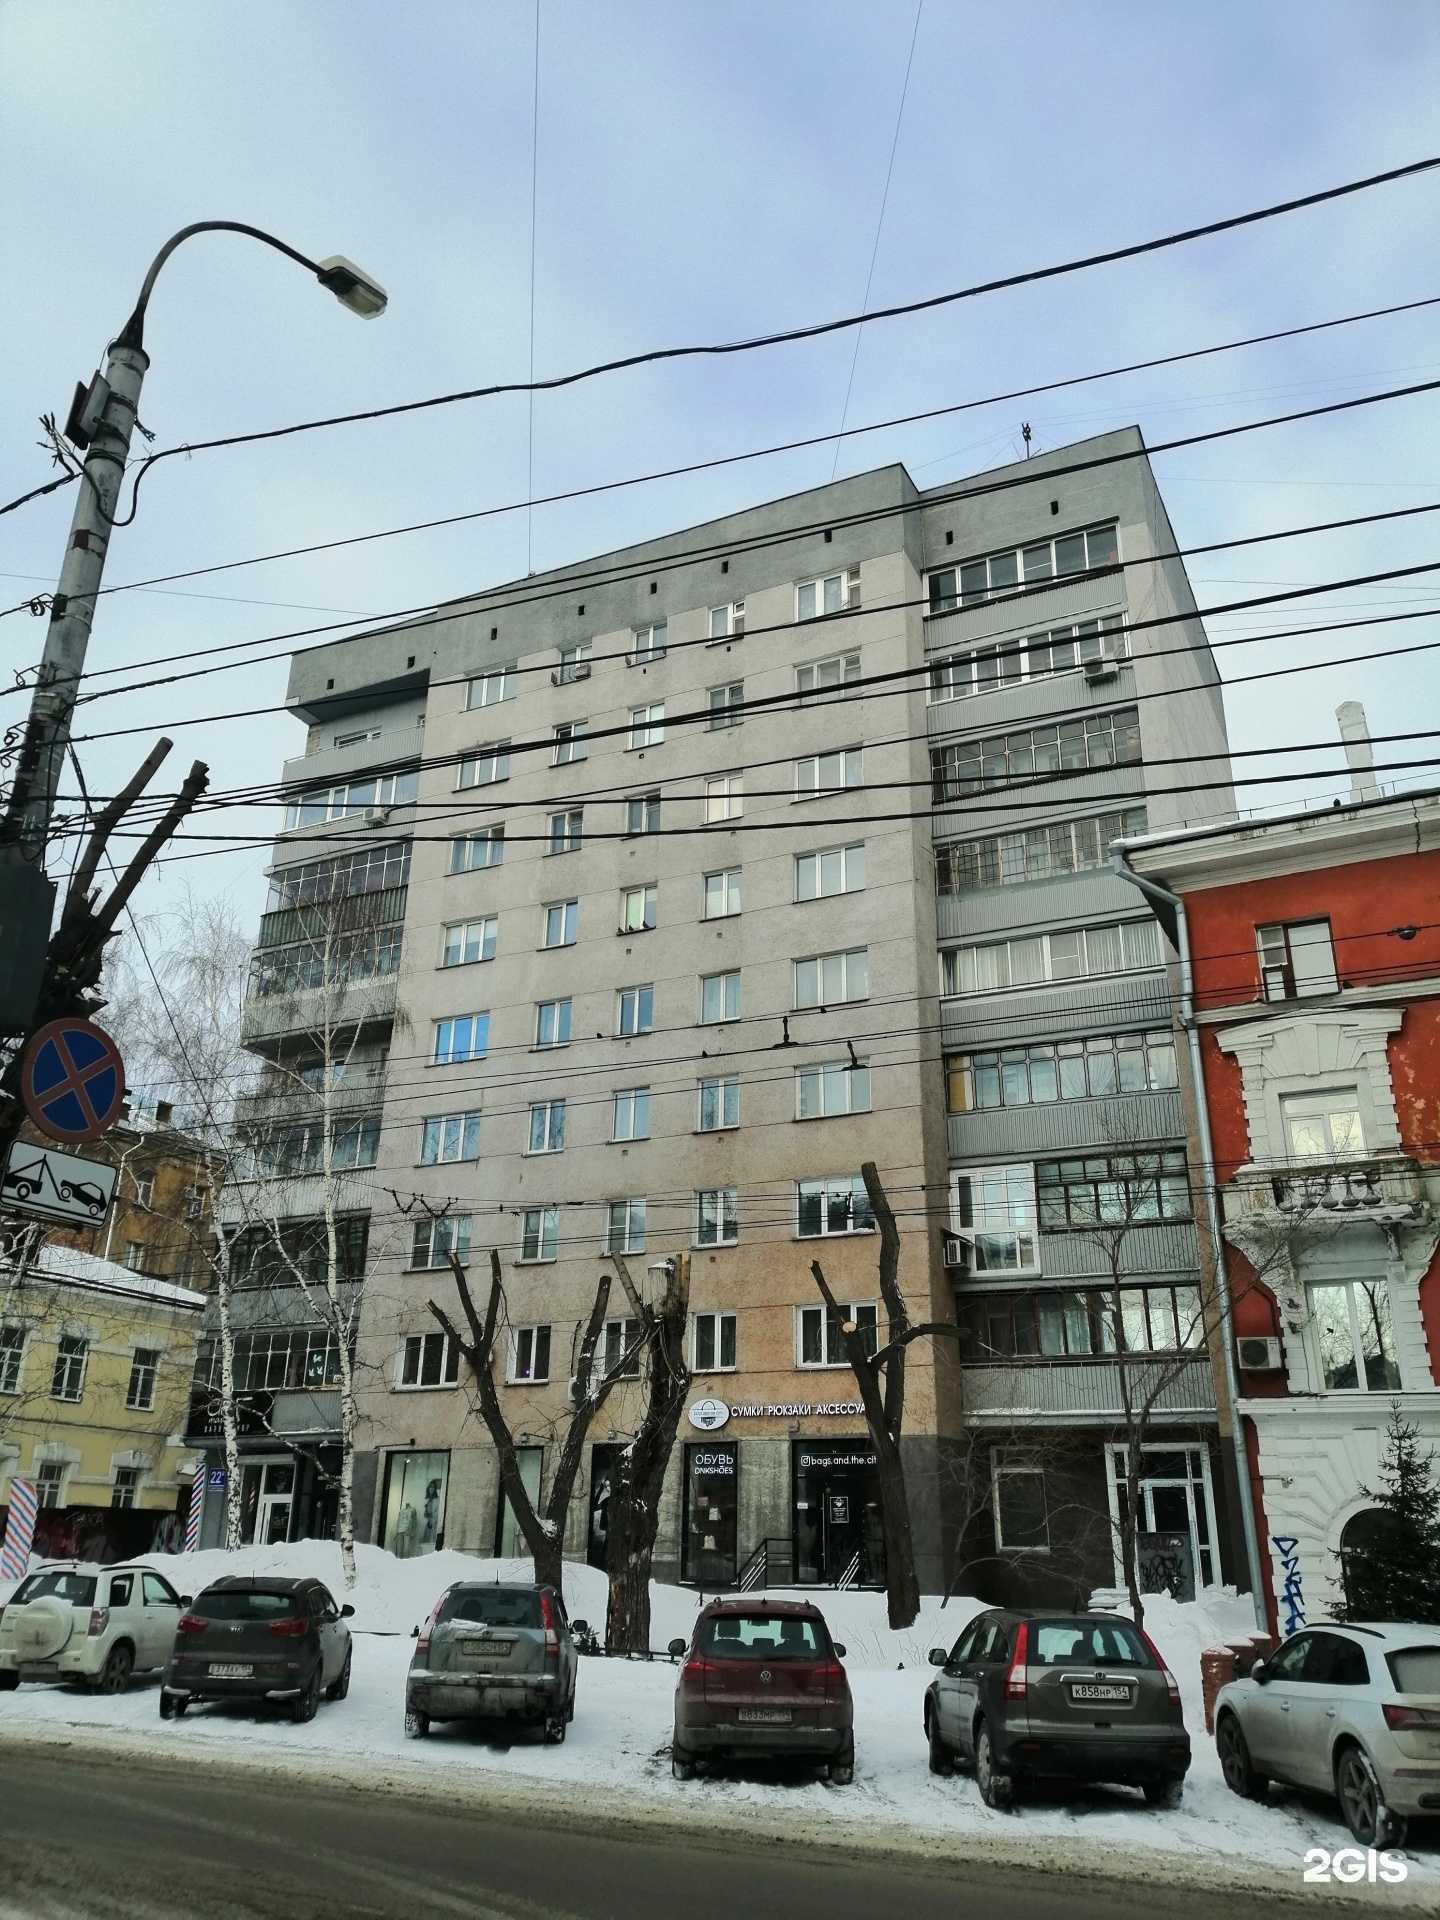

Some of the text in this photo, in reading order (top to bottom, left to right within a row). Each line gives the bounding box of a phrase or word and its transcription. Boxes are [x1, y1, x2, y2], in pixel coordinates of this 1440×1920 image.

[731, 1406, 764, 1417] СУМКИ
[768, 1405, 811, 1417] РЮКЗАКИ
[695, 1454, 734, 1465] ОБУВЬ
[1113, 1686, 1127, 1696] 154
